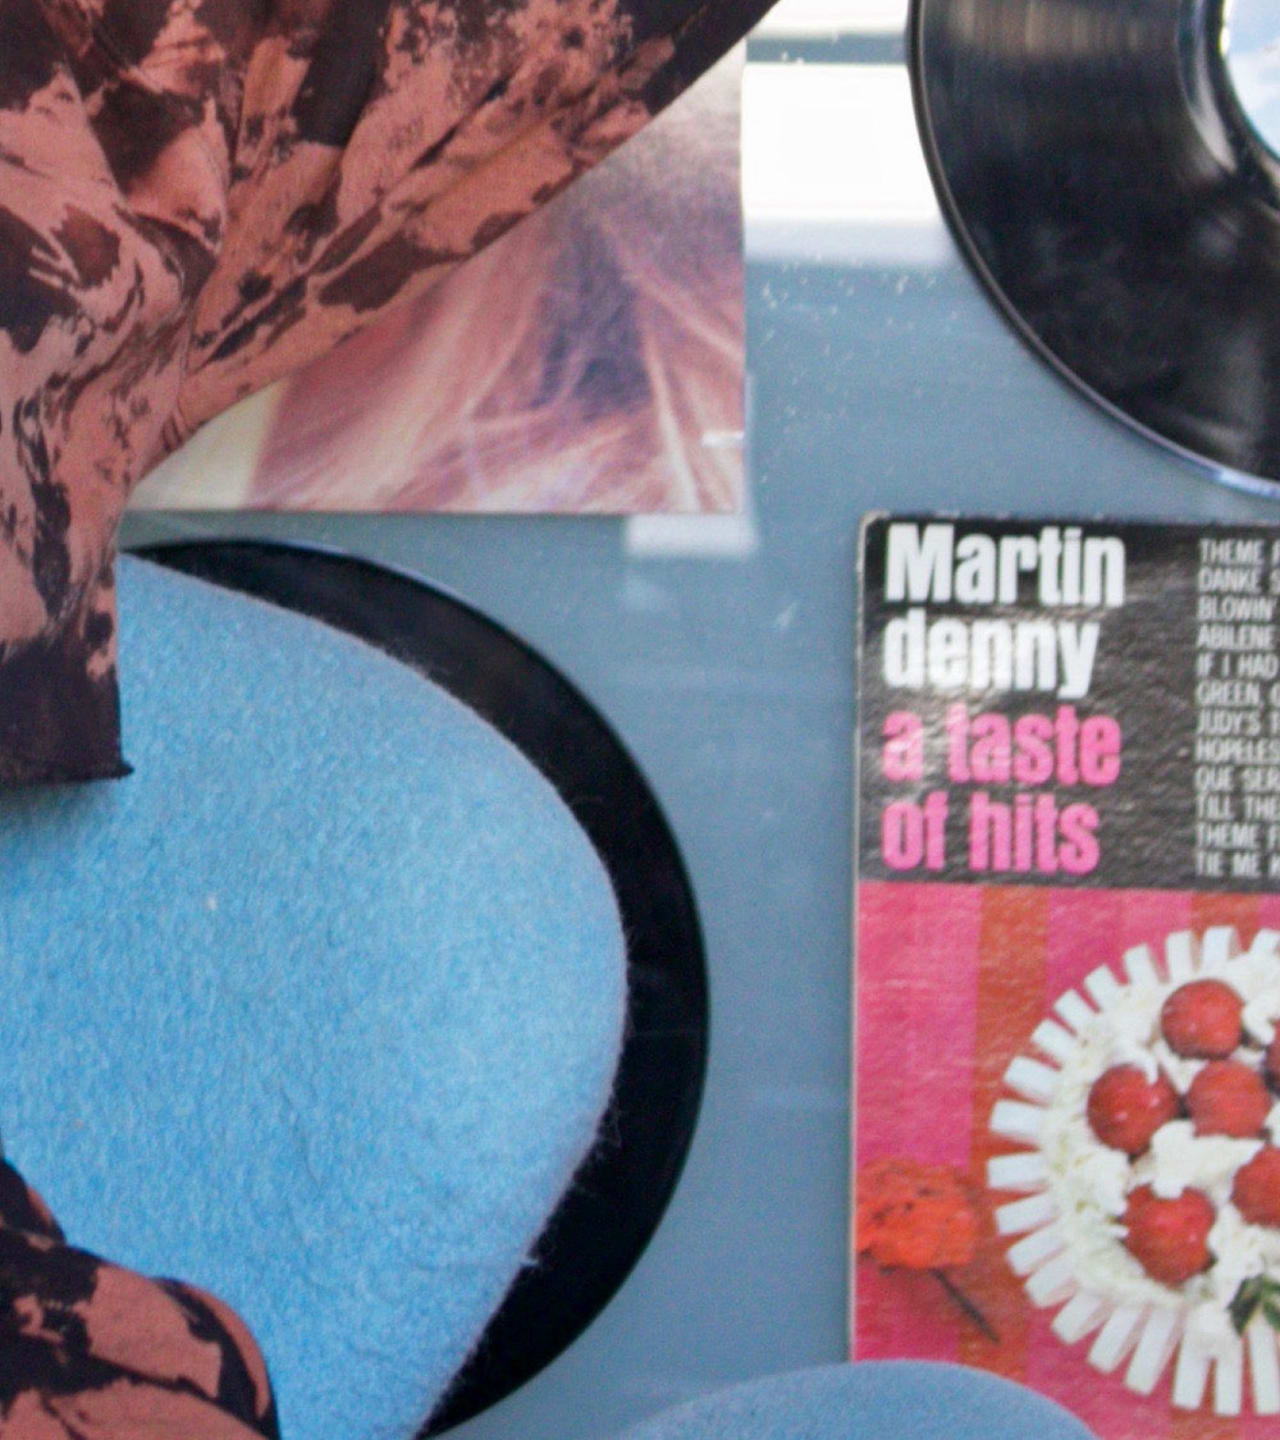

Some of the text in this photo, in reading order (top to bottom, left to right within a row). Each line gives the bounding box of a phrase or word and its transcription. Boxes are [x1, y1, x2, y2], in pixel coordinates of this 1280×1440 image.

[1199, 538, 1266, 564] THEME
[886, 523, 1126, 608] Martin
[1198, 567, 1262, 593] DANKE
[1197, 624, 1276, 651] ABILENE
[883, 607, 1100, 700] denny
[881, 702, 1122, 787] a taste
[1195, 765, 1234, 792] QUE
[1196, 794, 1234, 819] TILL
[881, 792, 1100, 875] of hits
[1196, 823, 1260, 849] THEME
[1196, 851, 1223, 876] TIE
[1232, 852, 1262, 877] ME
